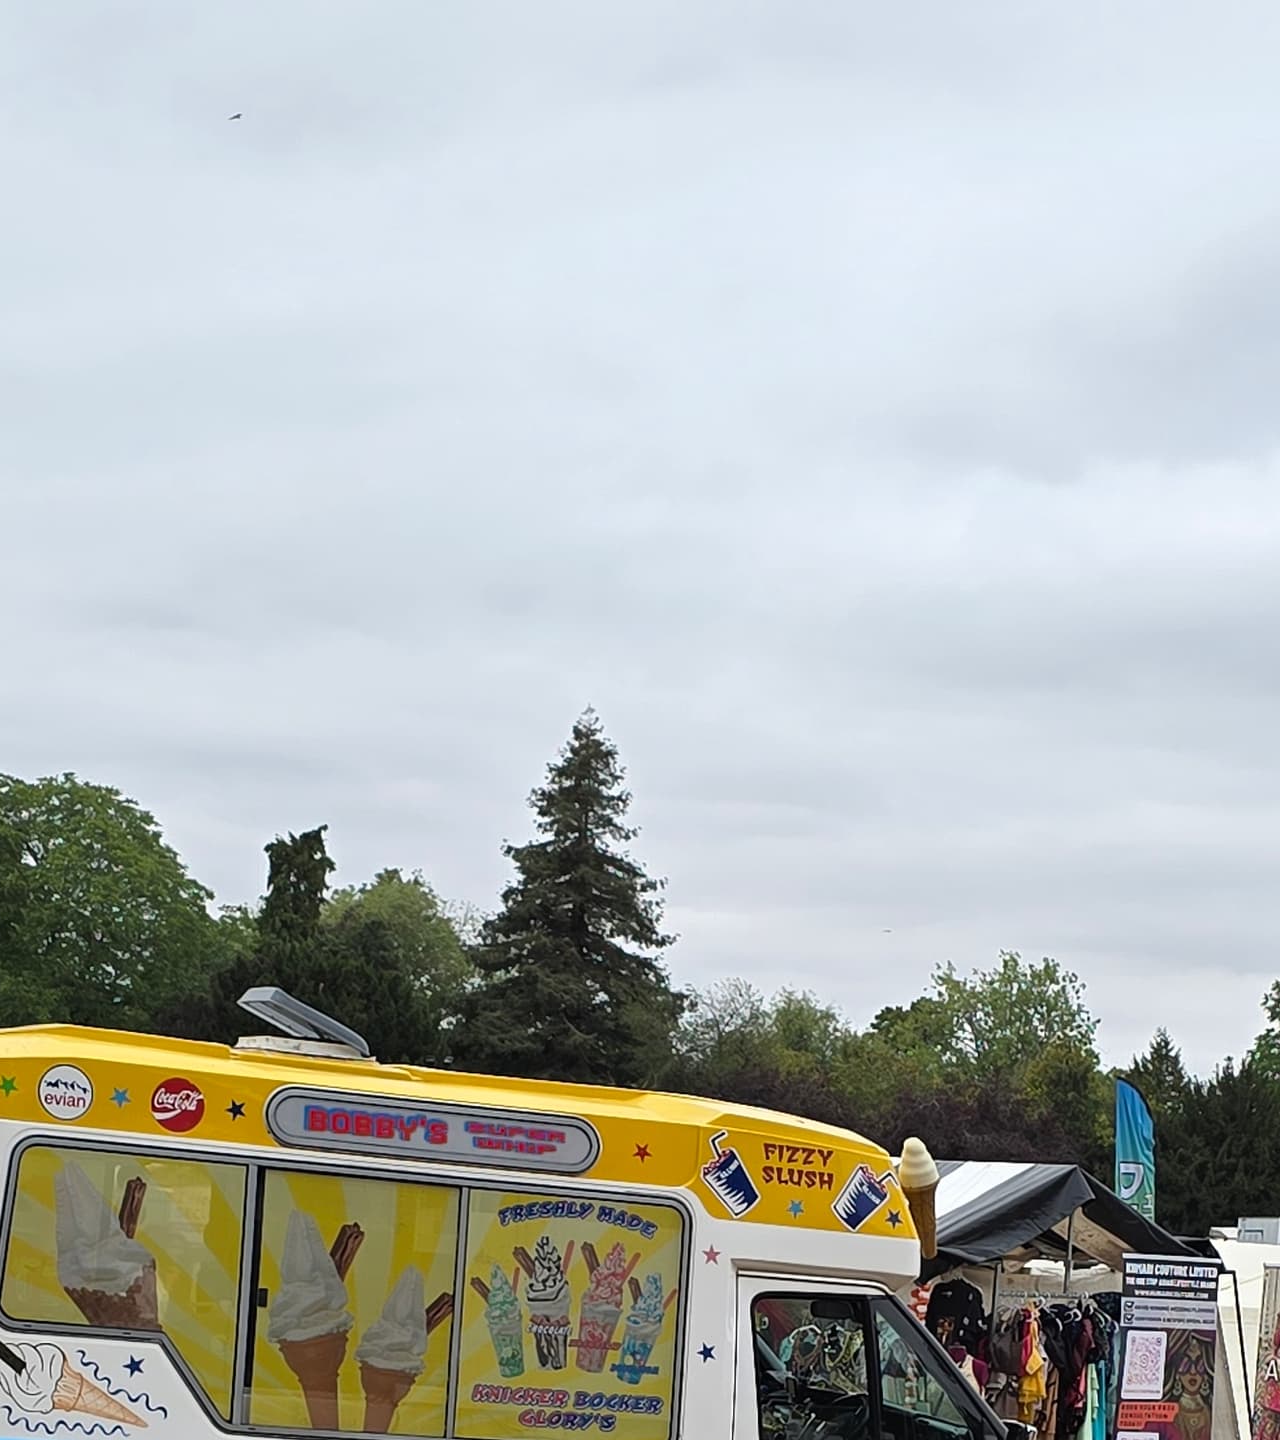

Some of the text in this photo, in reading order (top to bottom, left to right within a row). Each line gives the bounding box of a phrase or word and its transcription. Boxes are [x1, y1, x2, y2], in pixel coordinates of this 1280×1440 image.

[43, 1089, 87, 1109] evian
[304, 1104, 448, 1145] BOBBY'S
[464, 1121, 566, 1144] SUPER
[763, 1142, 834, 1167] FIZZY
[761, 1166, 834, 1191] SLUSH
[498, 1200, 658, 1240] FRESHLY MADE
[472, 1384, 664, 1415] KNICKER BOCKER
[518, 1408, 617, 1432] GLORY'S
